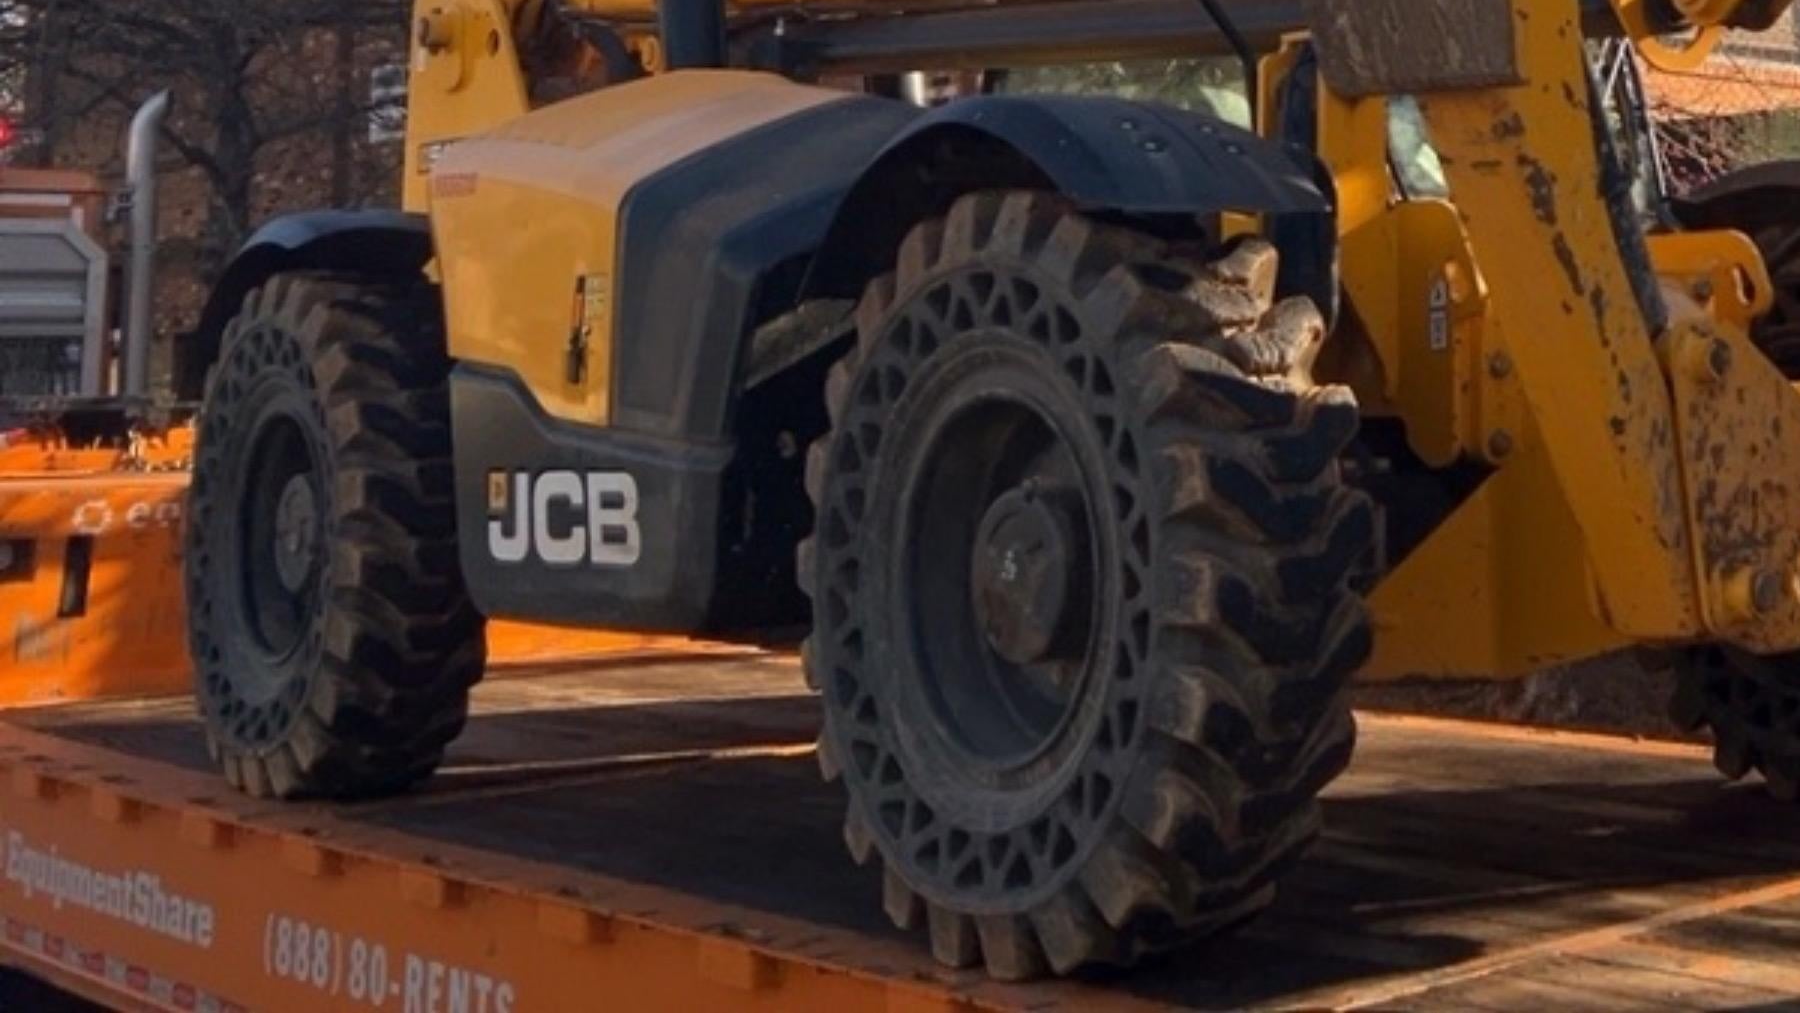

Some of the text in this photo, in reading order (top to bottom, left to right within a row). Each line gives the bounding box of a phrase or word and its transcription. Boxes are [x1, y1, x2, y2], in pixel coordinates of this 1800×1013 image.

[488, 469, 641, 565] JCB
[7, 828, 214, 948] EquipmentShare
[264, 911, 343, 996] (888)
